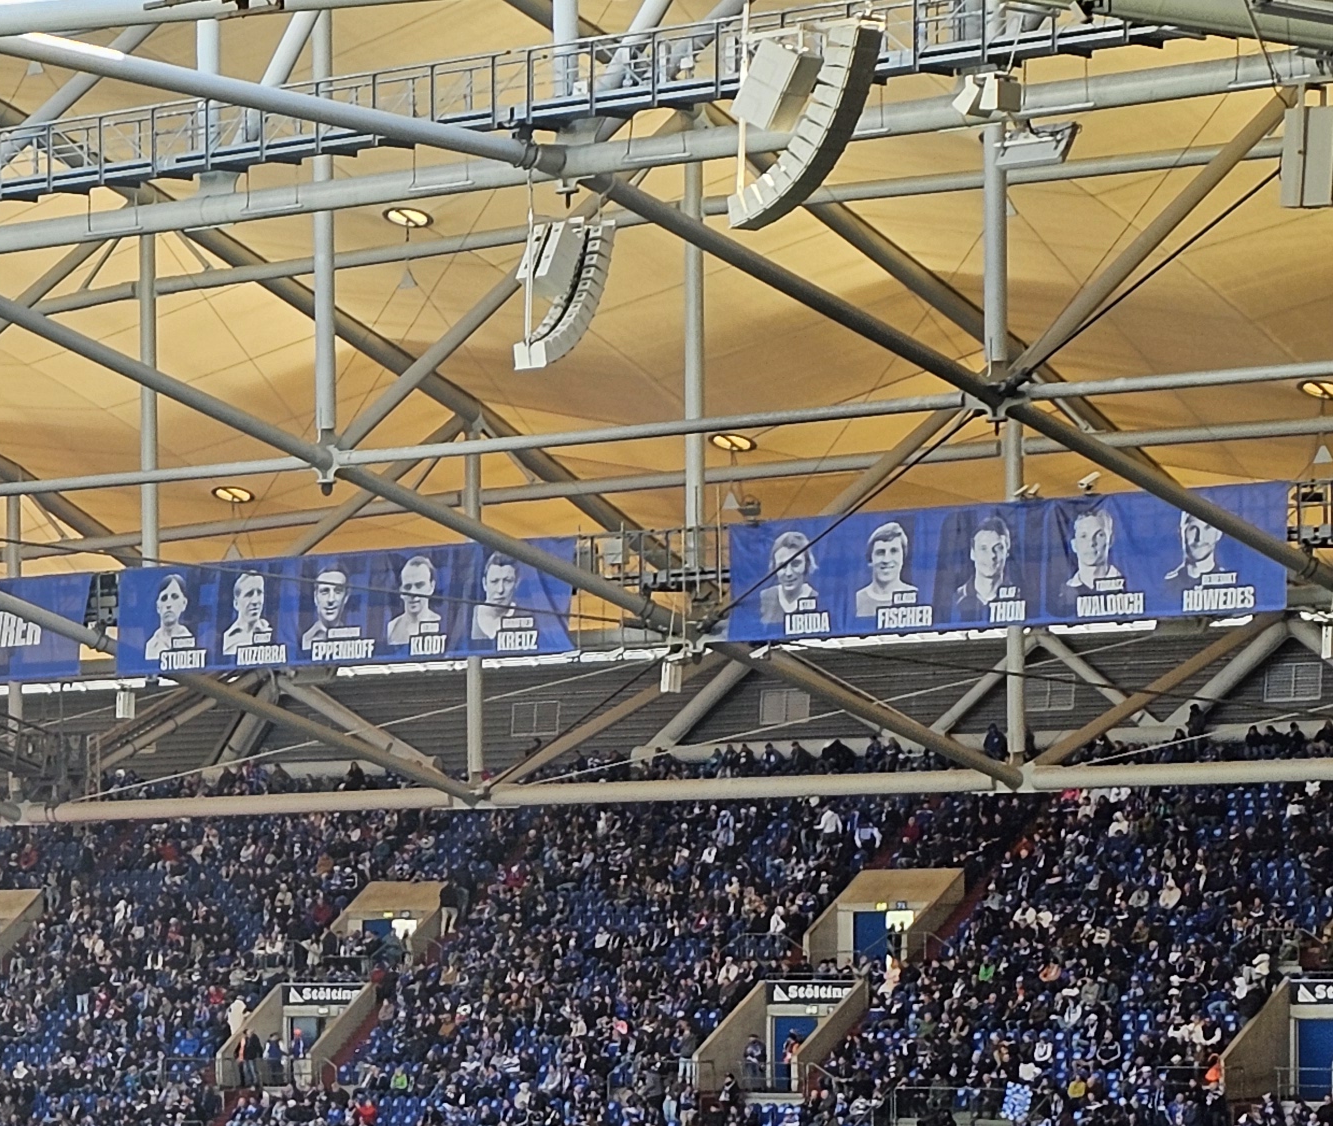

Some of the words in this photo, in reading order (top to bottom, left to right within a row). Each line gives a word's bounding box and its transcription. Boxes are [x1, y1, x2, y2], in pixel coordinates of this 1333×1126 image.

[1183, 584, 1255, 612] HÖWEDES
[877, 605, 933, 629] FISCHER
[989, 600, 1026, 622] THON
[785, 613, 830, 635] LIBUDA
[312, 639, 375, 661] EPPENHOFF
[497, 630, 538, 651] KREUZ
